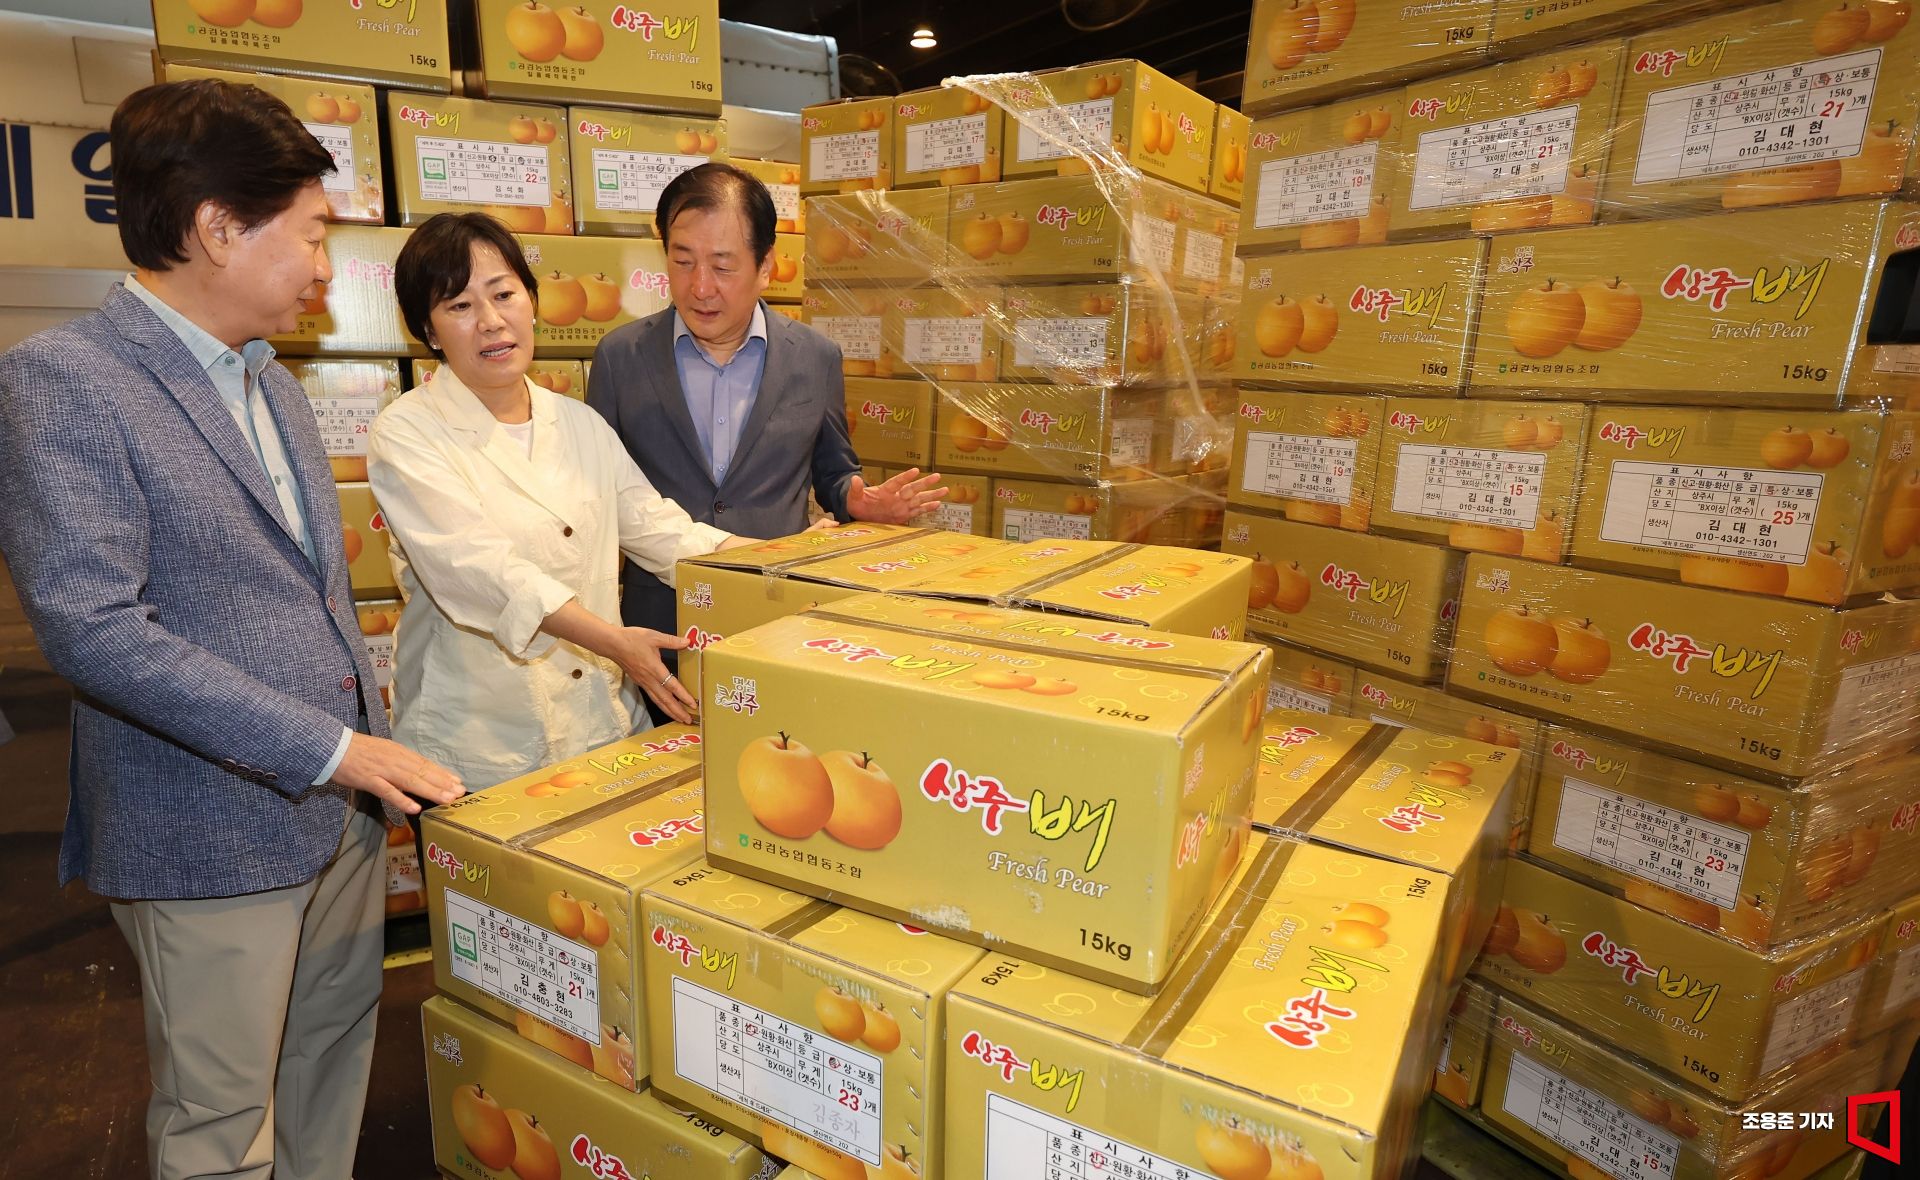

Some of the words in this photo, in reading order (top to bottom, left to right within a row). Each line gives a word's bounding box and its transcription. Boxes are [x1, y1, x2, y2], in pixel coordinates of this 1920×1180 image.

[356, 18, 390, 33] Fresh
[393, 23, 421, 36] Pear
[1446, 26, 1474, 42] 15kg
[410, 54, 437, 68] 15kg
[646, 48, 676, 62] Fresh
[676, 52, 700, 64] Pear
[690, 80, 713, 92] 15kg
[1829, 88, 1853, 99] 15kg
[1820, 100, 1846, 118] 21
[1538, 144, 1554, 159] 21
[1738, 136, 1830, 158] 010-4342-1301
[525, 174, 538, 184] 22
[1351, 176, 1364, 188] 19
[1379, 328, 1410, 344] Fresh
[1414, 331, 1440, 344] Pear
[1710, 318, 1762, 341] Fresh
[1767, 321, 1816, 339] Pear
[1422, 362, 1448, 376] 15kg
[1782, 364, 1828, 382] 15kg
[356, 424, 368, 434] 24
[1333, 466, 1344, 477] 19
[1509, 484, 1524, 497] 15
[1691, 490, 1715, 502] 상주시
[1776, 500, 1798, 512] 15kg
[1648, 518, 1670, 528] 생산자
[1772, 509, 1795, 526] 25
[1695, 531, 1778, 549] 010-4342-1301
[1349, 609, 1376, 627] Fresh
[1378, 616, 1403, 633] Pear
[1386, 648, 1412, 665] 15kg
[1672, 682, 1720, 708] Fresh
[1726, 695, 1770, 719] Pear
[1095, 706, 1150, 722] 15kg
[1739, 736, 1782, 762] 15kg
[1634, 820, 1656, 835] 상주시
[1708, 846, 1728, 861] 15kg
[752, 837, 863, 880] 공검농업협동조합
[1704, 854, 1725, 872] 23
[987, 850, 1049, 885] Fresh
[1054, 868, 1112, 900] Pear
[1638, 858, 1712, 890] 010-4342-1301
[1406, 876, 1432, 900] 15kg
[1078, 928, 1134, 963] 15kg
[569, 970, 586, 986] 15kg
[980, 960, 1020, 986] 15kg
[568, 980, 582, 1000] 21
[513, 982, 574, 1020] 010-4803-3283
[1623, 993, 1666, 1023] Fresh
[1670, 1013, 1708, 1042] Pear
[719, 1062, 742, 1080] 생산자
[757, 1040, 780, 1059] 상주시
[841, 1078, 863, 1096] 15kg
[1681, 1054, 1722, 1084] 15kg
[838, 1088, 860, 1113] 23
[1643, 1154, 1660, 1171] 15
